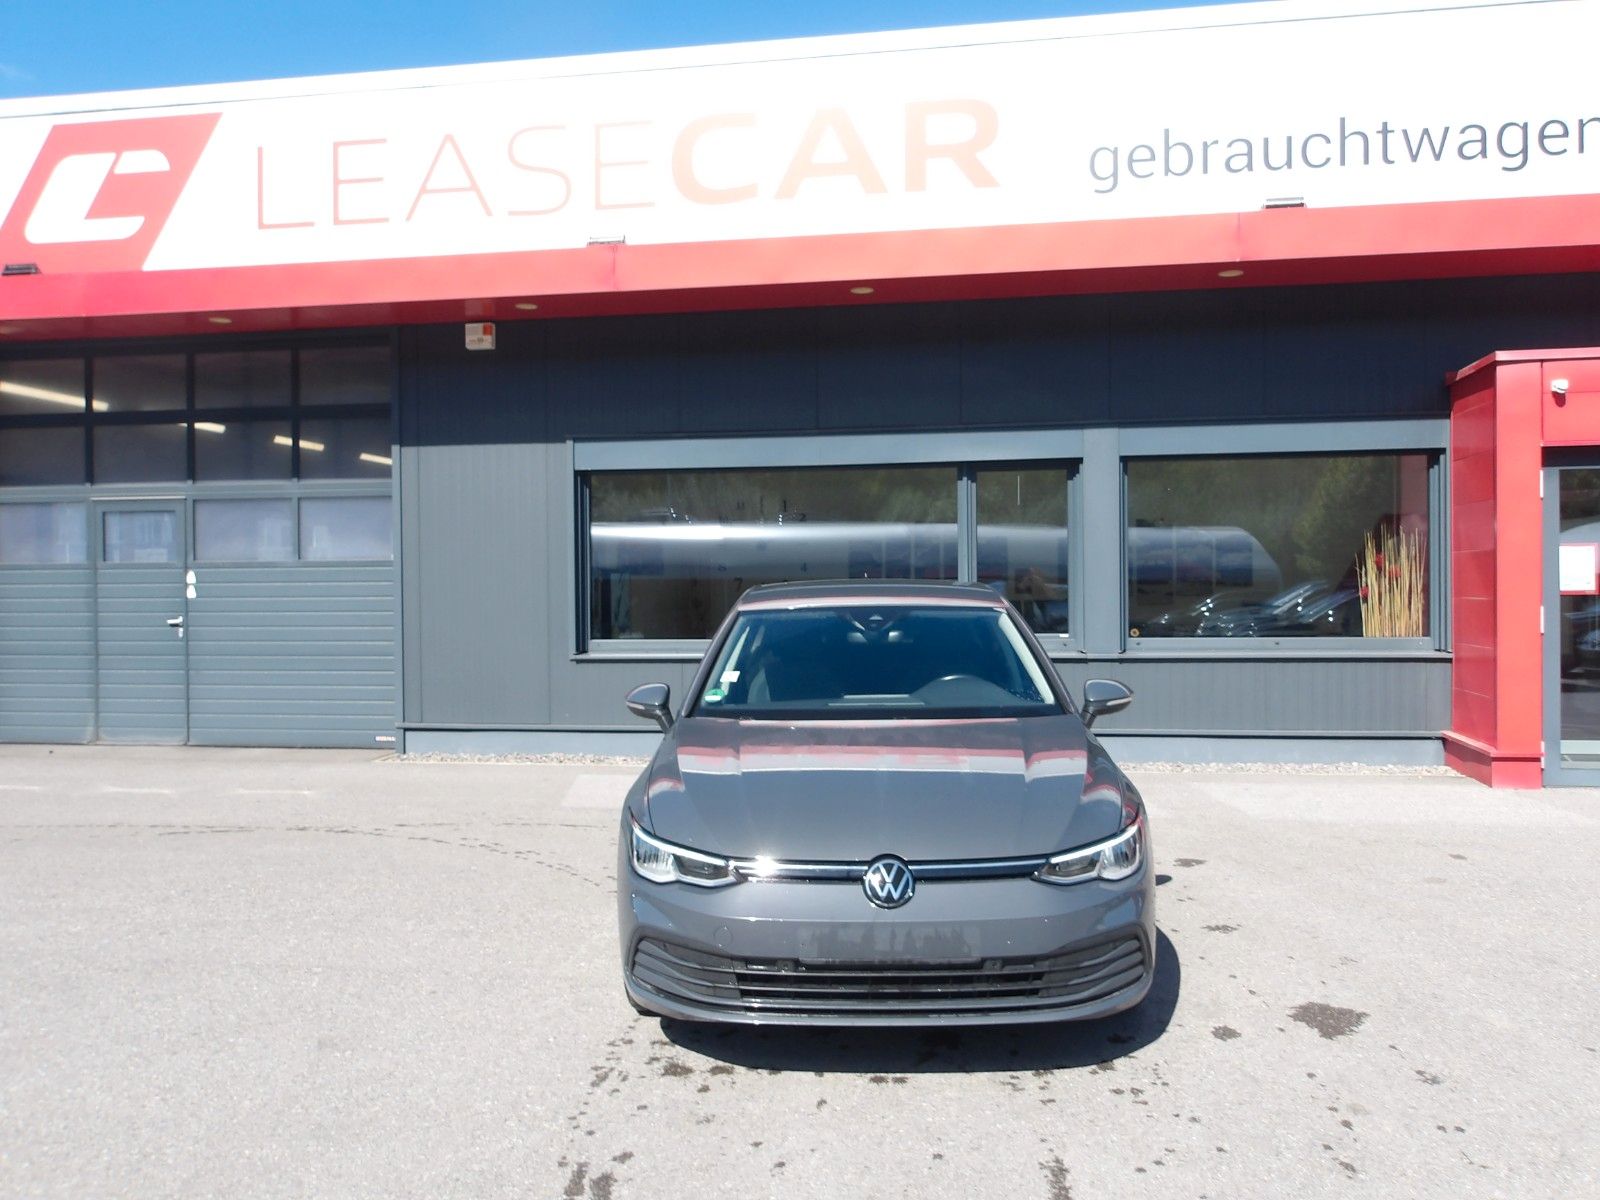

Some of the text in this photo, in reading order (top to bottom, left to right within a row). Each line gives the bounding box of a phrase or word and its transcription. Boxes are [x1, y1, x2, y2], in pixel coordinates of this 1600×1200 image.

[256, 98, 1001, 230] LEASECAR
[1089, 116, 1600, 194] gebrauchtwagen
[866, 860, 911, 903] VW
